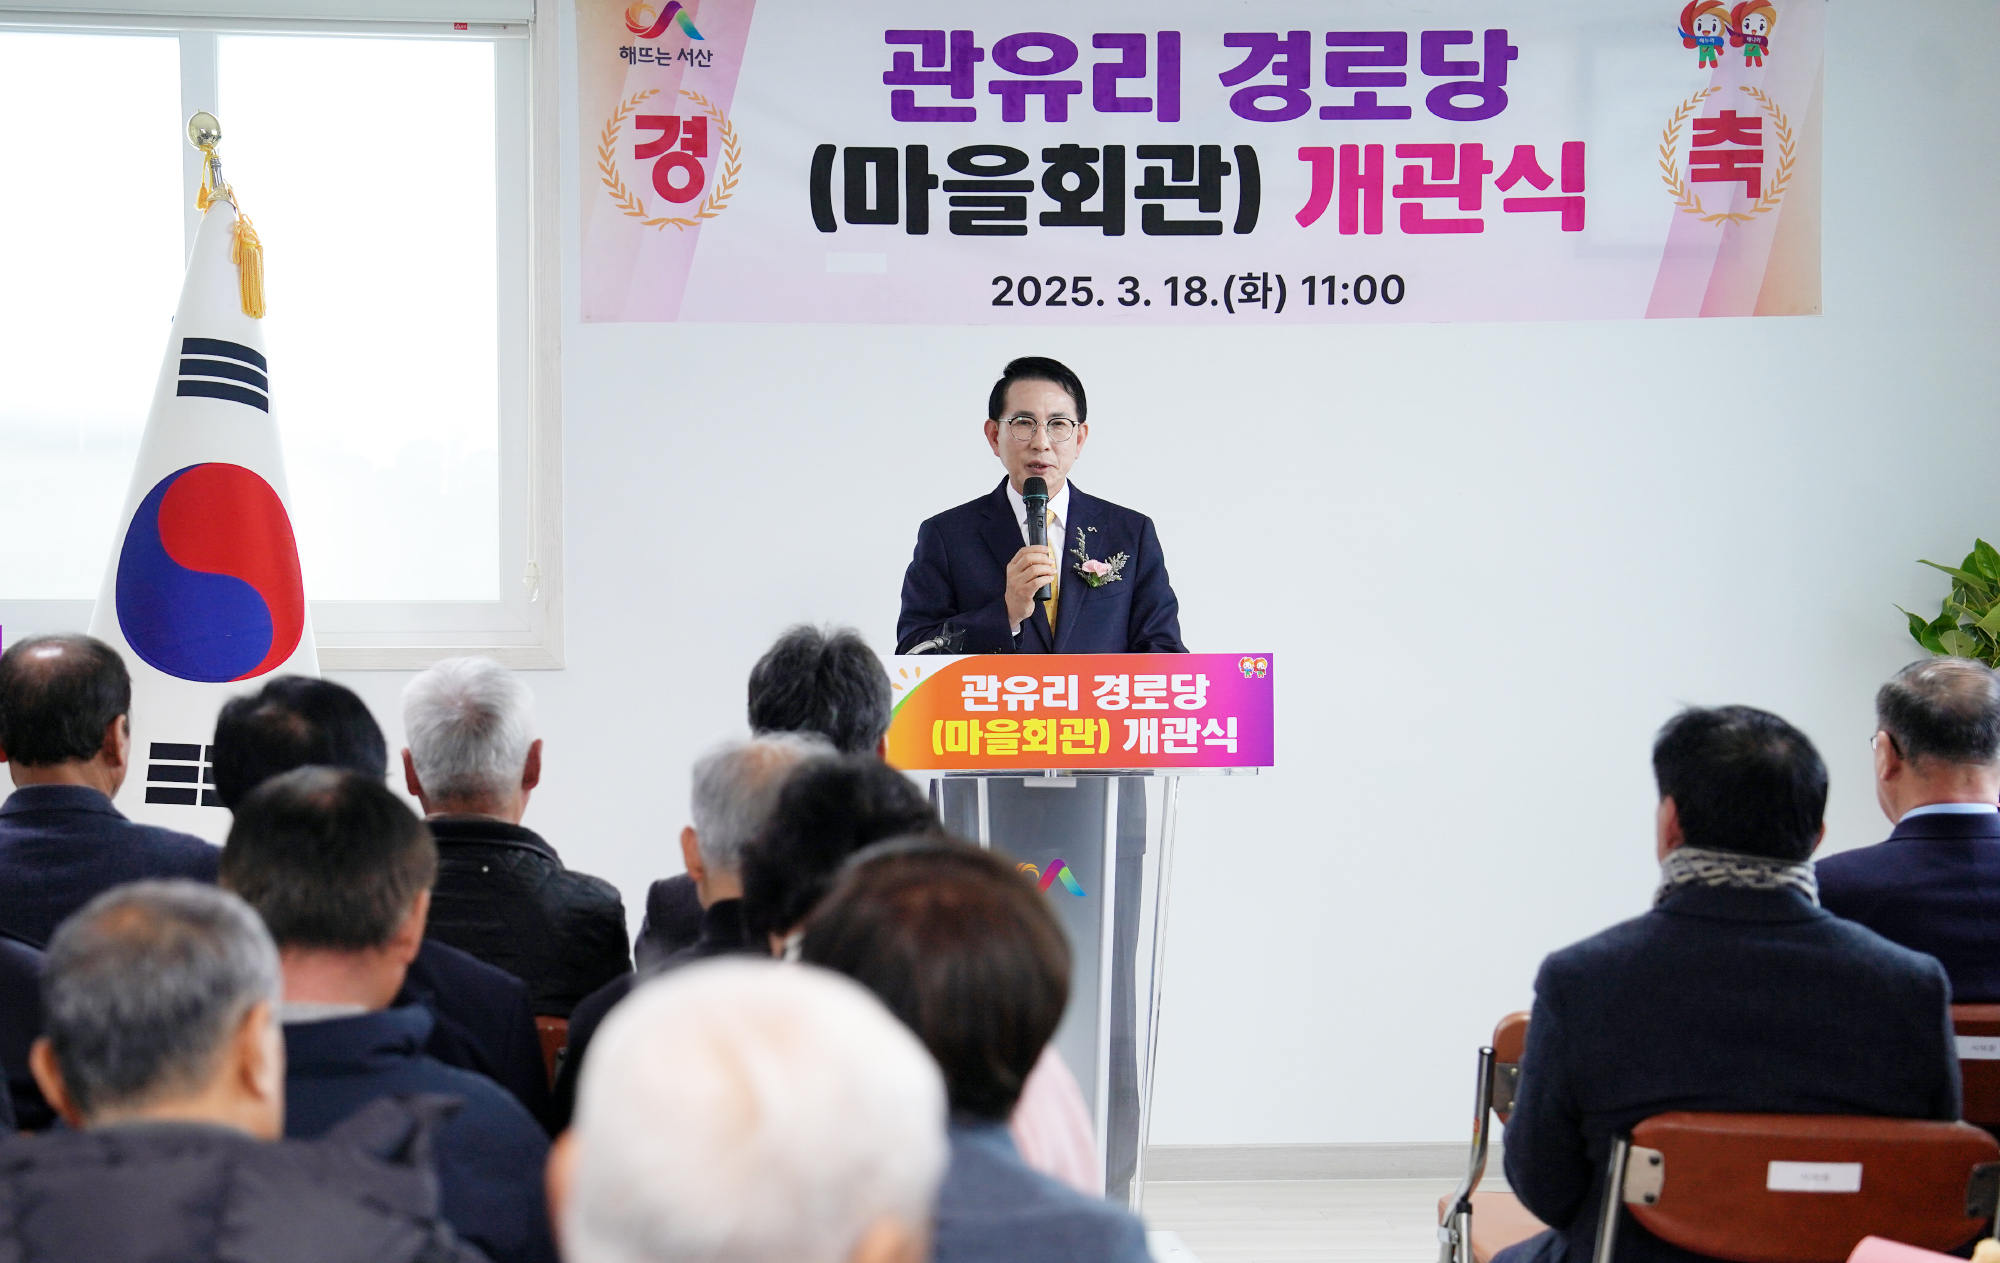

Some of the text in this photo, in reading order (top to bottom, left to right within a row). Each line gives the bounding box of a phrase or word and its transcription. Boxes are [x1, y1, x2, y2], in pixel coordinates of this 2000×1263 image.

[619, 45, 714, 68] 해뜨는 서산
[882, 28, 1519, 123] 관유리 경로당
[633, 114, 709, 204] 경
[1689, 109, 1765, 199] 축
[809, 141, 1586, 237] (마을회관) 개관식
[991, 271, 1406, 314] 2025. 3. 18.(화) 11:00
[960, 673, 1211, 712] 관유리 경로당
[931, 716, 1239, 756] (마을회관) 개관식
